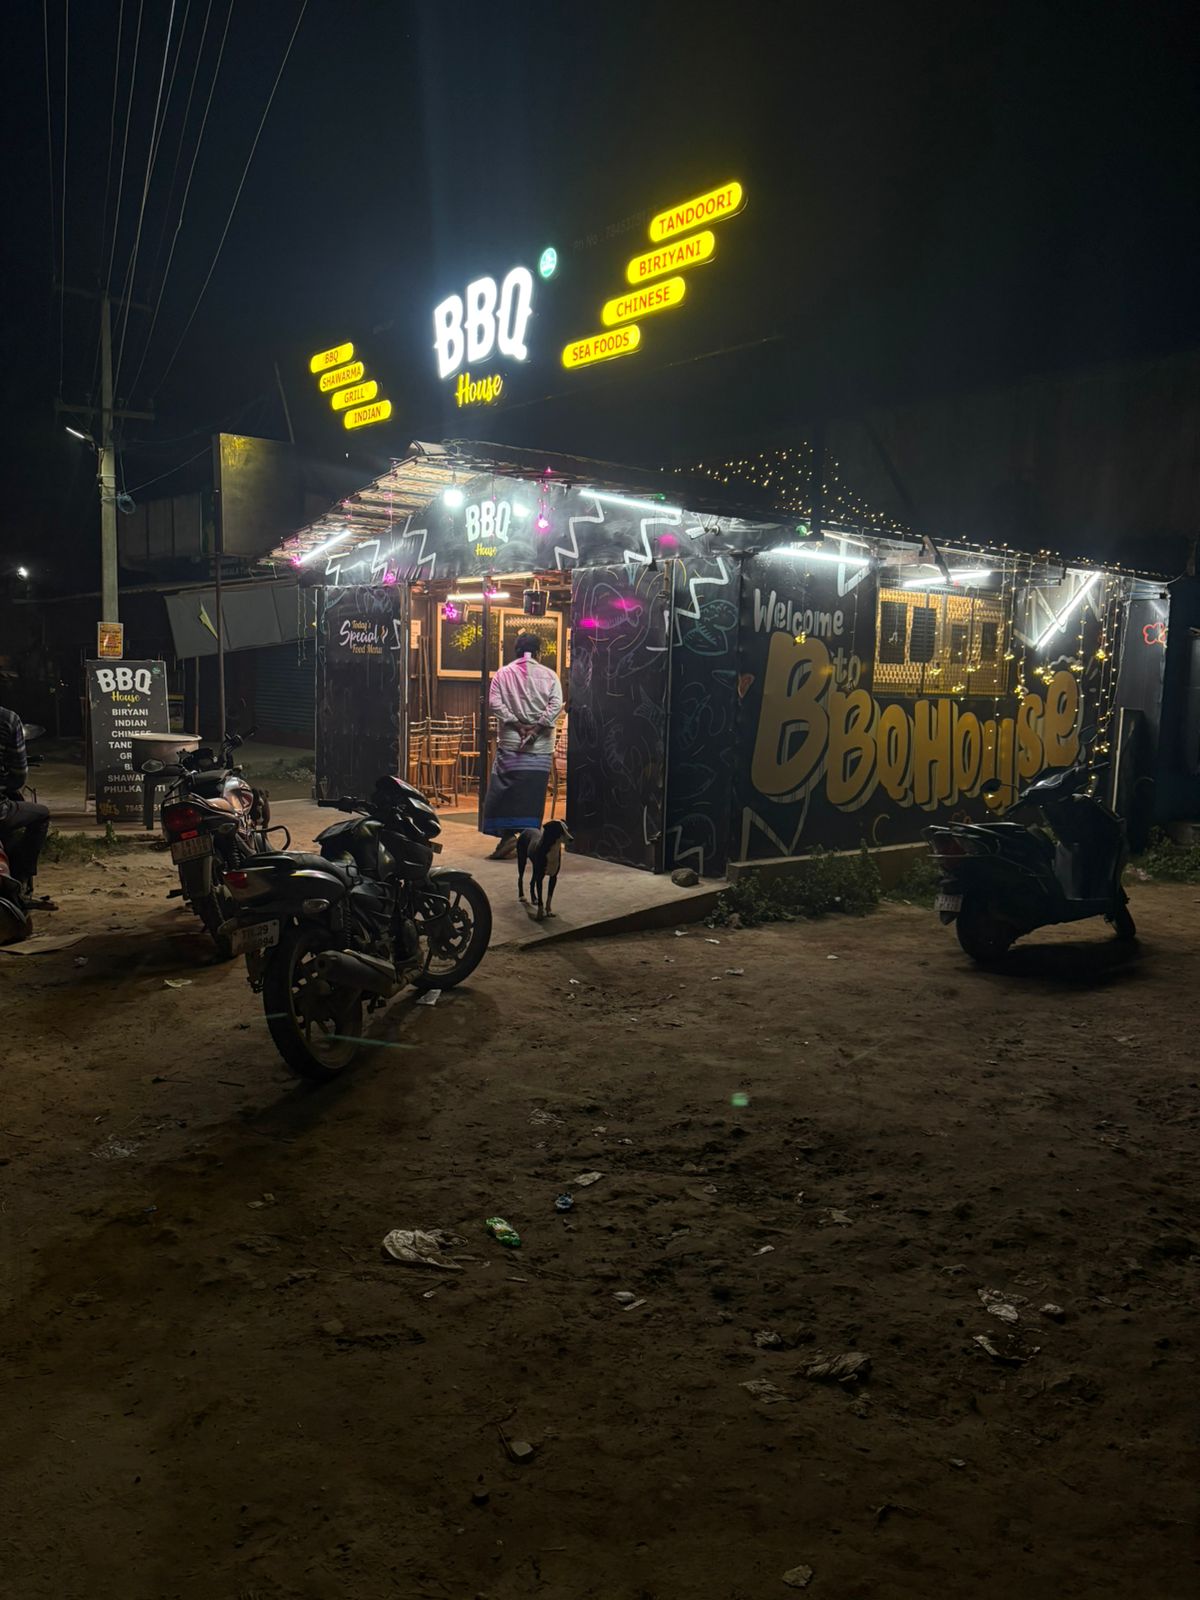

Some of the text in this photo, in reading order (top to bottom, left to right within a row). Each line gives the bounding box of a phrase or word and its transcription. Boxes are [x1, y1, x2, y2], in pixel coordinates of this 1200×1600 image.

[658, 190, 733, 234] TANDOORI
[638, 240, 701, 276] BIRIYANI
[616, 285, 671, 317] CHINESE
[433, 266, 533, 379] BBQ
[324, 351, 338, 364] BBQ
[572, 333, 630, 361] SEA FOODS
[322, 365, 362, 388] SHAWARMA
[455, 373, 503, 407] House
[343, 386, 366, 403] GRILL
[353, 405, 381, 423] INDIAN
[465, 501, 511, 543] BBQ
[474, 543, 498, 558] House
[753, 588, 844, 635] Welcome
[339, 619, 380, 649] Special
[96, 667, 152, 695] BBQ
[833, 647, 861, 691] to
[111, 691, 141, 703] House
[111, 708, 149, 717] BIRYANI
[114, 719, 147, 727] INDIAN
[104, 784, 142, 793] PHULKA
